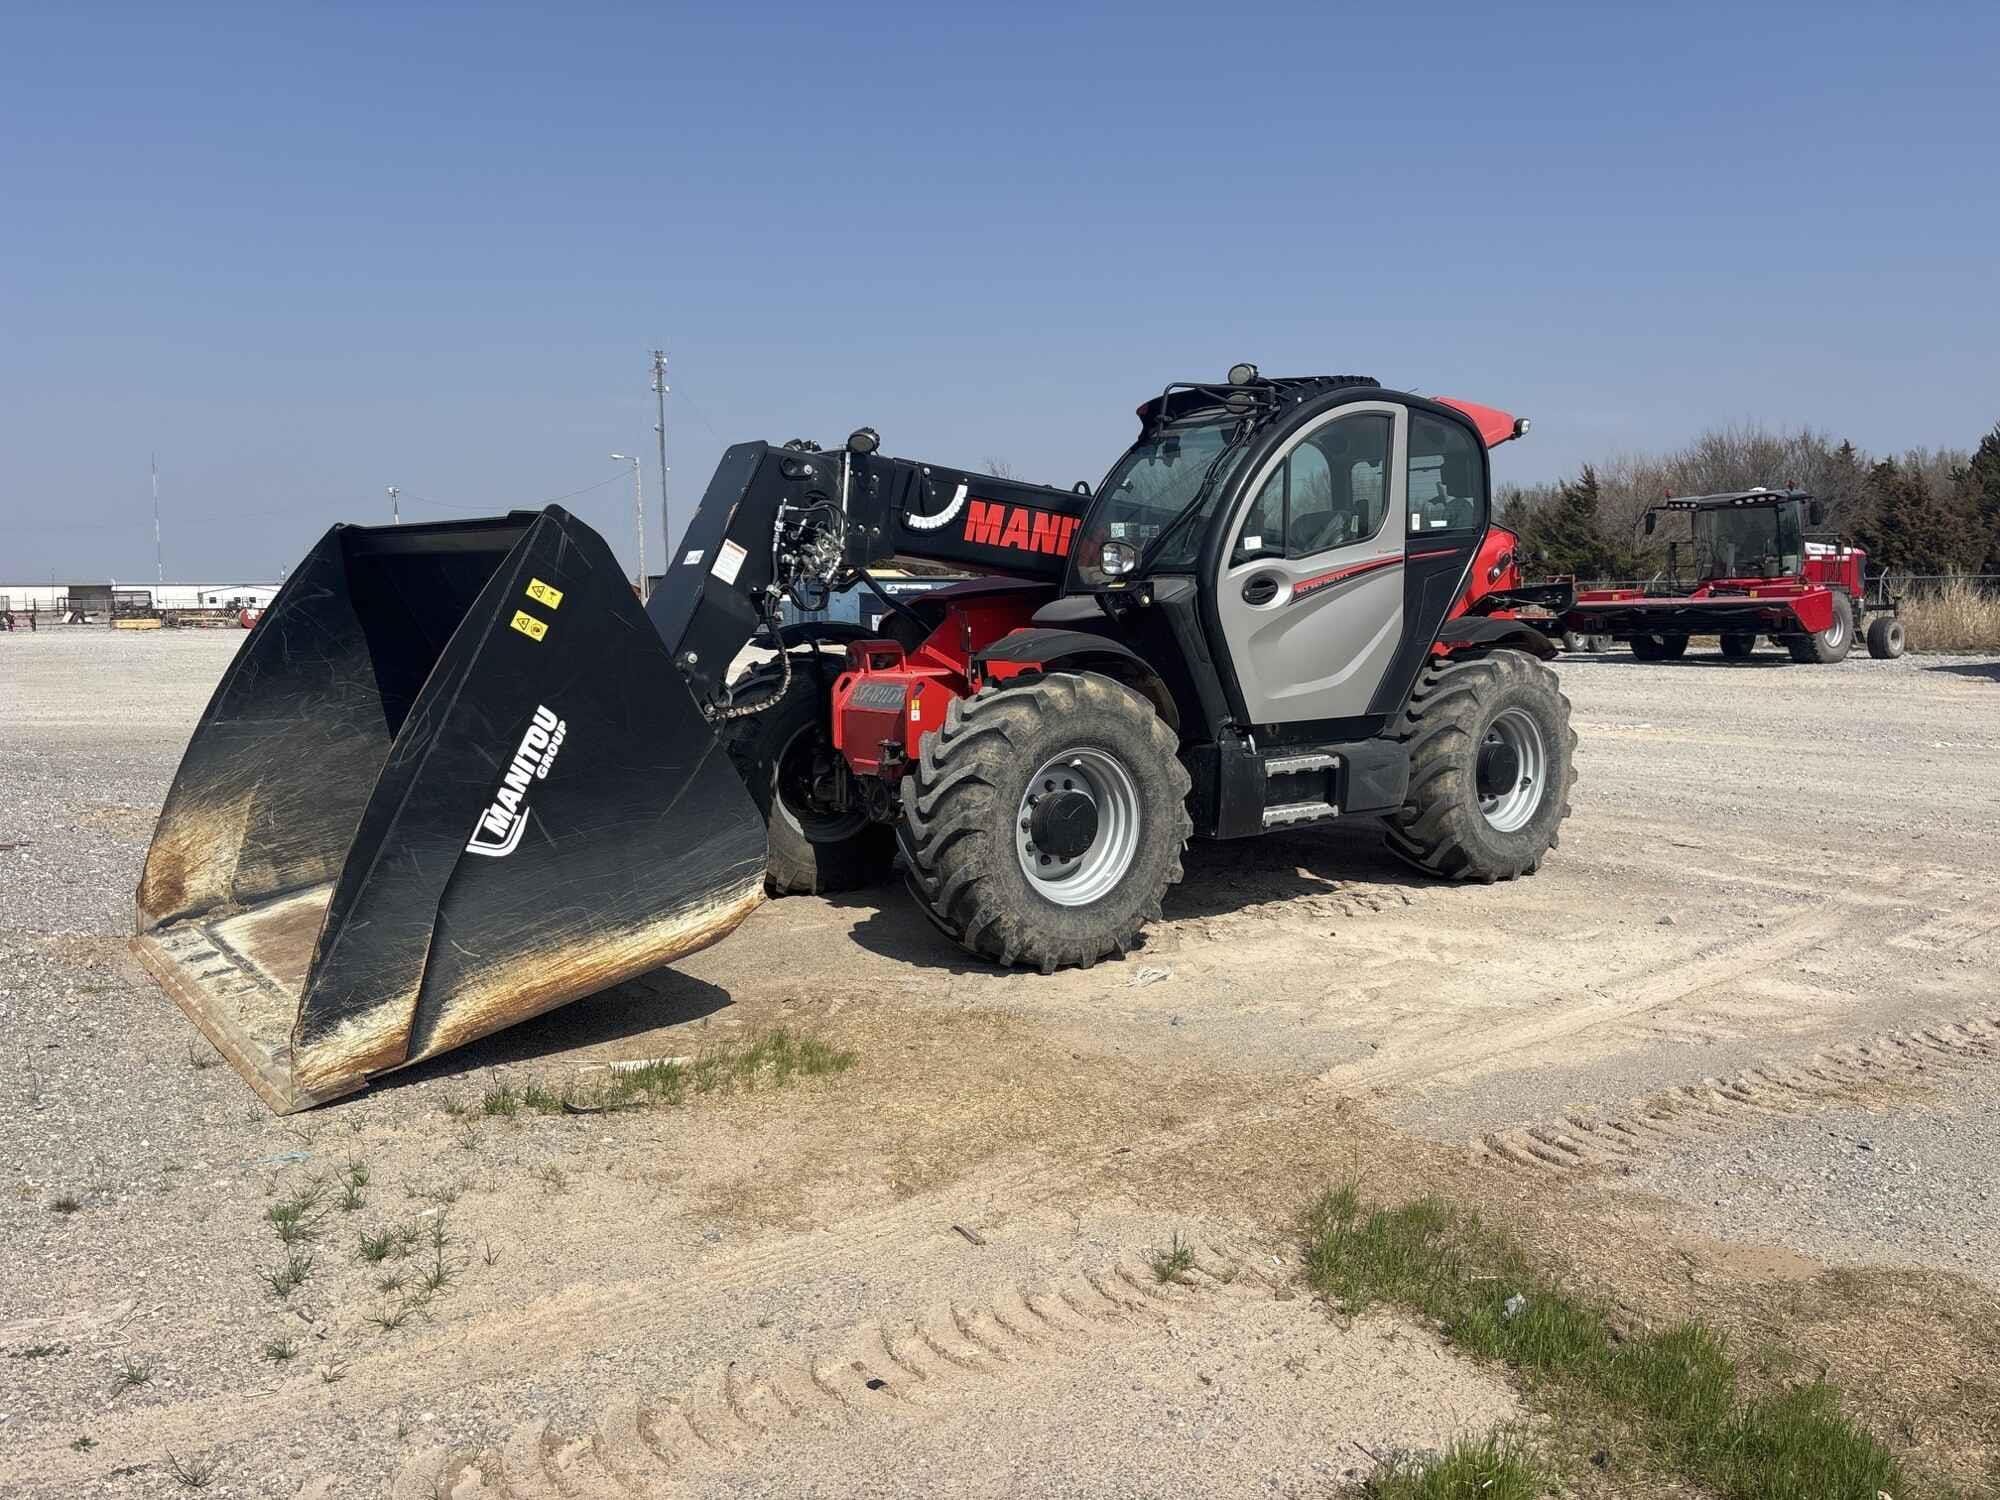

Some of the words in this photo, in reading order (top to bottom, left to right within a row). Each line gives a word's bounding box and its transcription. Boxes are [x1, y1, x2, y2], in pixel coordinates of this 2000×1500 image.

[964, 500, 1082, 557] MANI
[483, 704, 558, 838] MANITOU
[536, 719, 567, 780] GROUP
